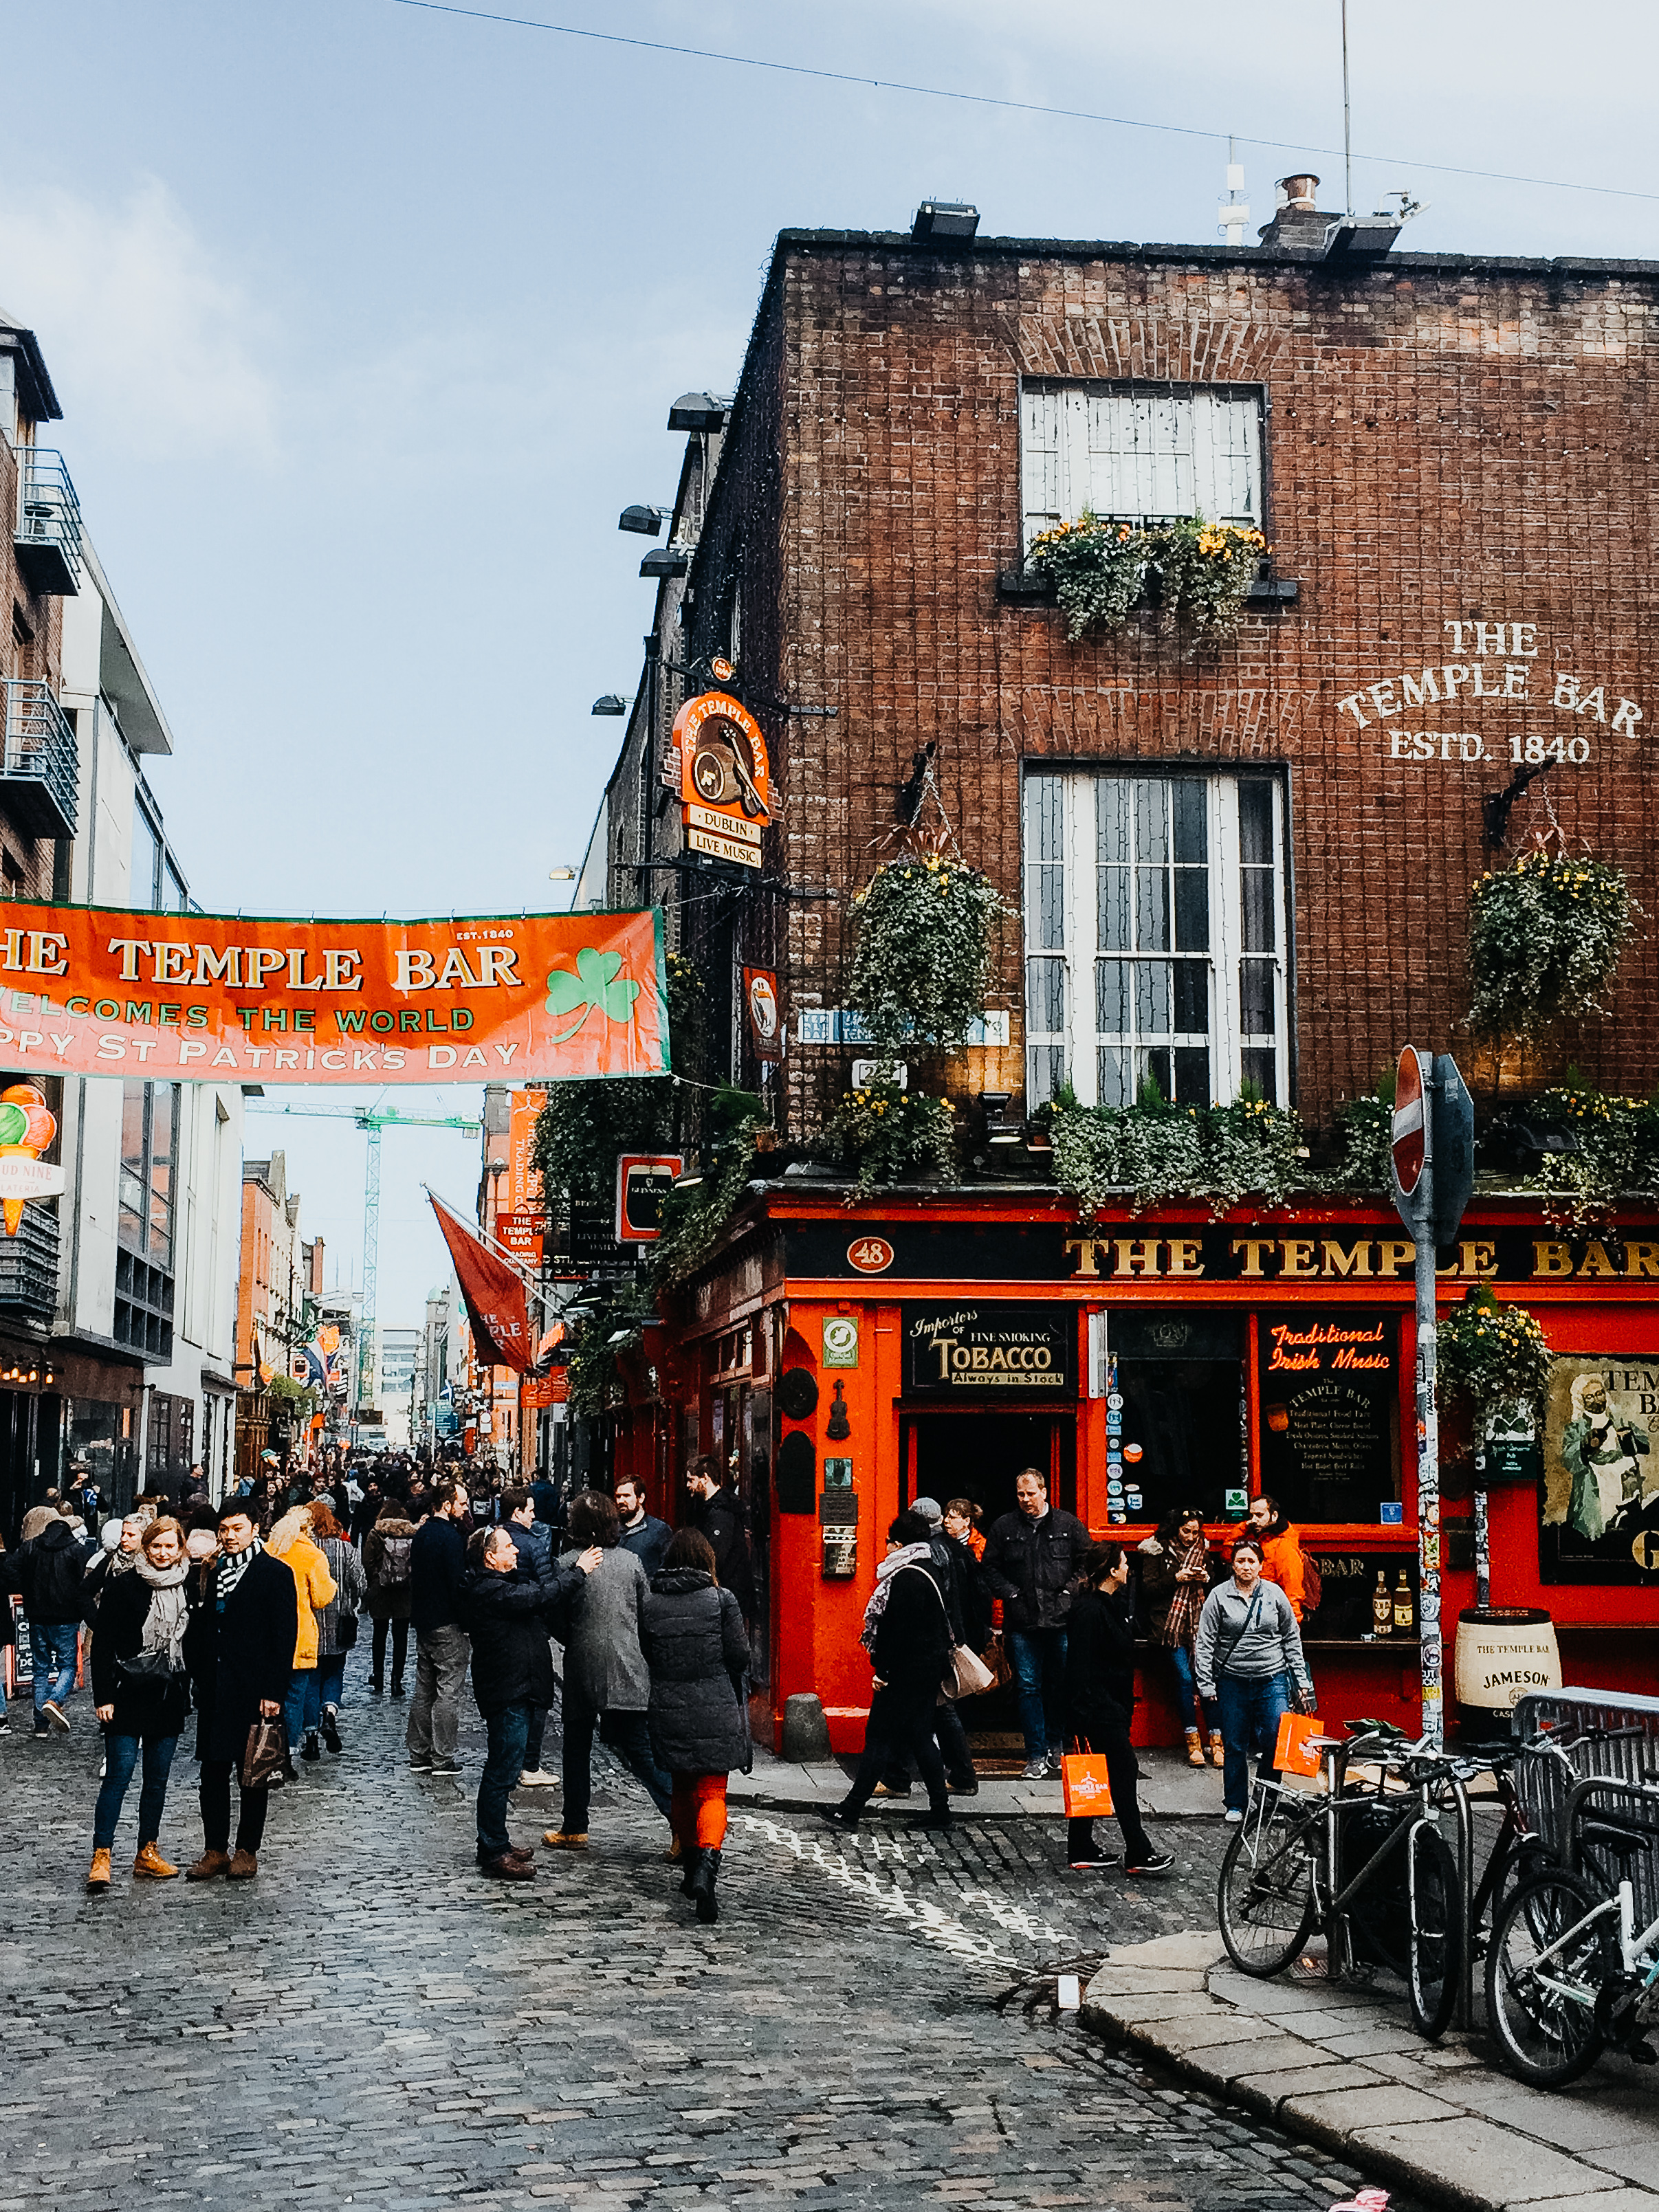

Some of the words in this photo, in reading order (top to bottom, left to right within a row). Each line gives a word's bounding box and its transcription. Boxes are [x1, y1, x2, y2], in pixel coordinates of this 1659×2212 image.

[1444, 620, 1538, 657] THE
[1335, 663, 1530, 730] TEMPLE
[1549, 672, 1644, 739] BAR
[685, 714, 701, 755] THE
[698, 700, 751, 734] TEMPLE
[750, 730, 765, 778] BAR
[1387, 729, 1494, 762] ESTD.
[1509, 735, 1591, 764] 1840
[705, 812, 748, 836] DUBLIN
[696, 834, 720, 854] LIVE
[723, 844, 757, 863] MUSIC
[108, 938, 364, 992] TEMPLE
[395, 945, 521, 991] BAR
[0, 986, 209, 1028] ELCOMES
[236, 1008, 316, 1032] THE
[335, 1008, 474, 1033] WORLD
[23, 1165, 53, 1181] NINE
[515, 1139, 525, 1193] TRADING
[503, 1226, 534, 1237] TEMPL
[512, 1217, 532, 1226] THE
[509, 1237, 533, 1246] BAR
[855, 1242, 886, 1264] 48
[1065, 1239, 1206, 1276] THE
[1531, 1241, 1659, 1276] BAR
[909, 1309, 978, 1338] Importers
[952, 1326, 965, 1334] OF
[1271, 1322, 1385, 1346] Traditional
[970, 1332, 996, 1342] FINE
[998, 1332, 1051, 1342] SMOKING
[930, 1338, 1052, 1380] TOBACCO
[1268, 1347, 1321, 1370] Irish
[1331, 1347, 1390, 1369] Music
[953, 1373, 1001, 1384] Always
[1007, 1373, 1020, 1384] in
[1023, 1373, 1062, 1384] Stock
[1289, 1385, 1342, 1408] TEMPLE
[1346, 1389, 1371, 1409] BAR
[1320, 1558, 1365, 1575] BAR
[1477, 1645, 1495, 1655] THE
[1497, 1645, 1534, 1654] TEMPLE
[1483, 1670, 1550, 1689] JAMESON
